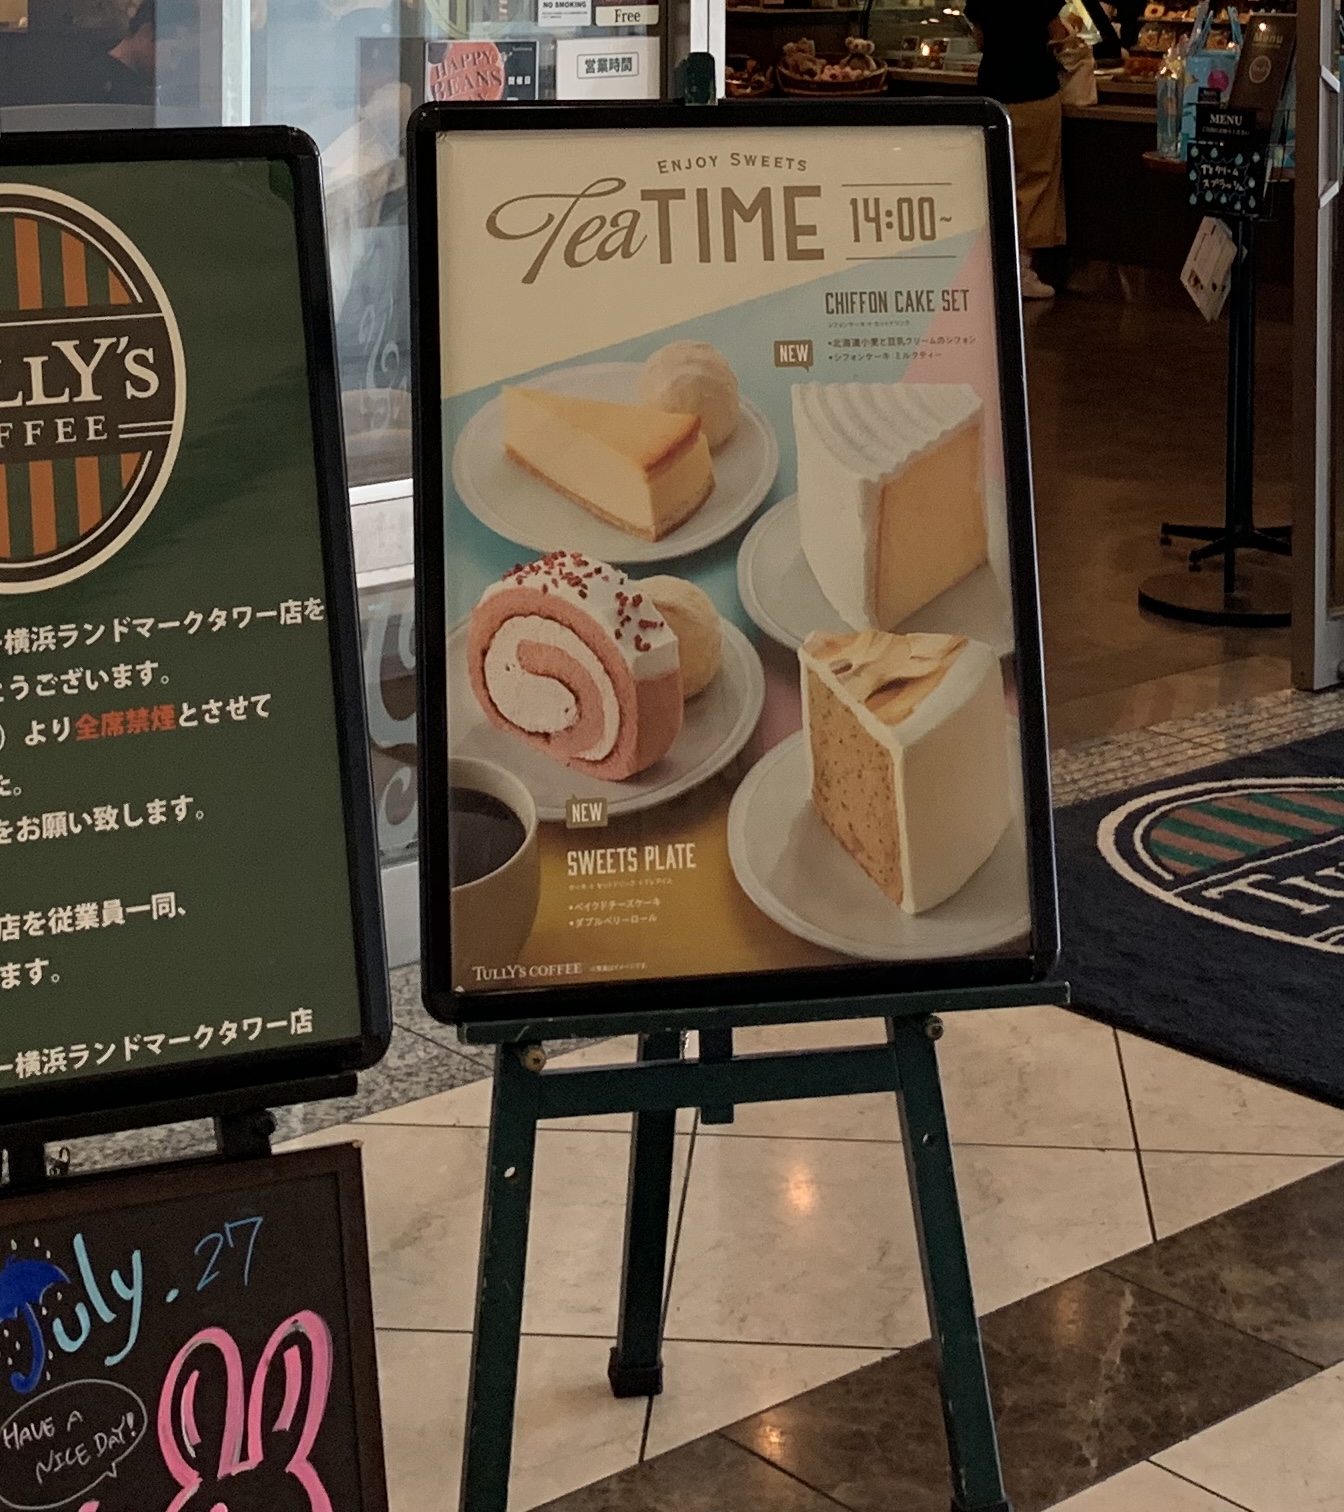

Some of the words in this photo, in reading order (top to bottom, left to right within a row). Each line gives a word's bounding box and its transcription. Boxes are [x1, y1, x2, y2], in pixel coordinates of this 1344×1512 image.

[614, 9, 641, 23] Free
[434, 50, 493, 80] HAPPY
[585, 57, 633, 74] 営業時間
[431, 70, 503, 101] BEANS
[1210, 113, 1243, 127] MENU
[657, 155, 719, 174] ENJOY
[730, 152, 807, 172] SWEETS
[825, 291, 889, 315] CHIFFON
[895, 290, 935, 313] CAKE
[942, 289, 970, 312] SET
[779, 344, 809, 363] NEW
[572, 802, 603, 823] NEW
[567, 847, 638, 876] SWEETS
[644, 843, 697, 871] PLATE
[472, 965, 527, 981] TULLY'S
[529, 963, 583, 978] COFFEE
[195, 1216, 264, 1291] 27
[3, 1417, 55, 1450] HAVE
[66, 1410, 84, 1432] A
[36, 1446, 91, 1485] NICE
[94, 1412, 138, 1457] DAY!
